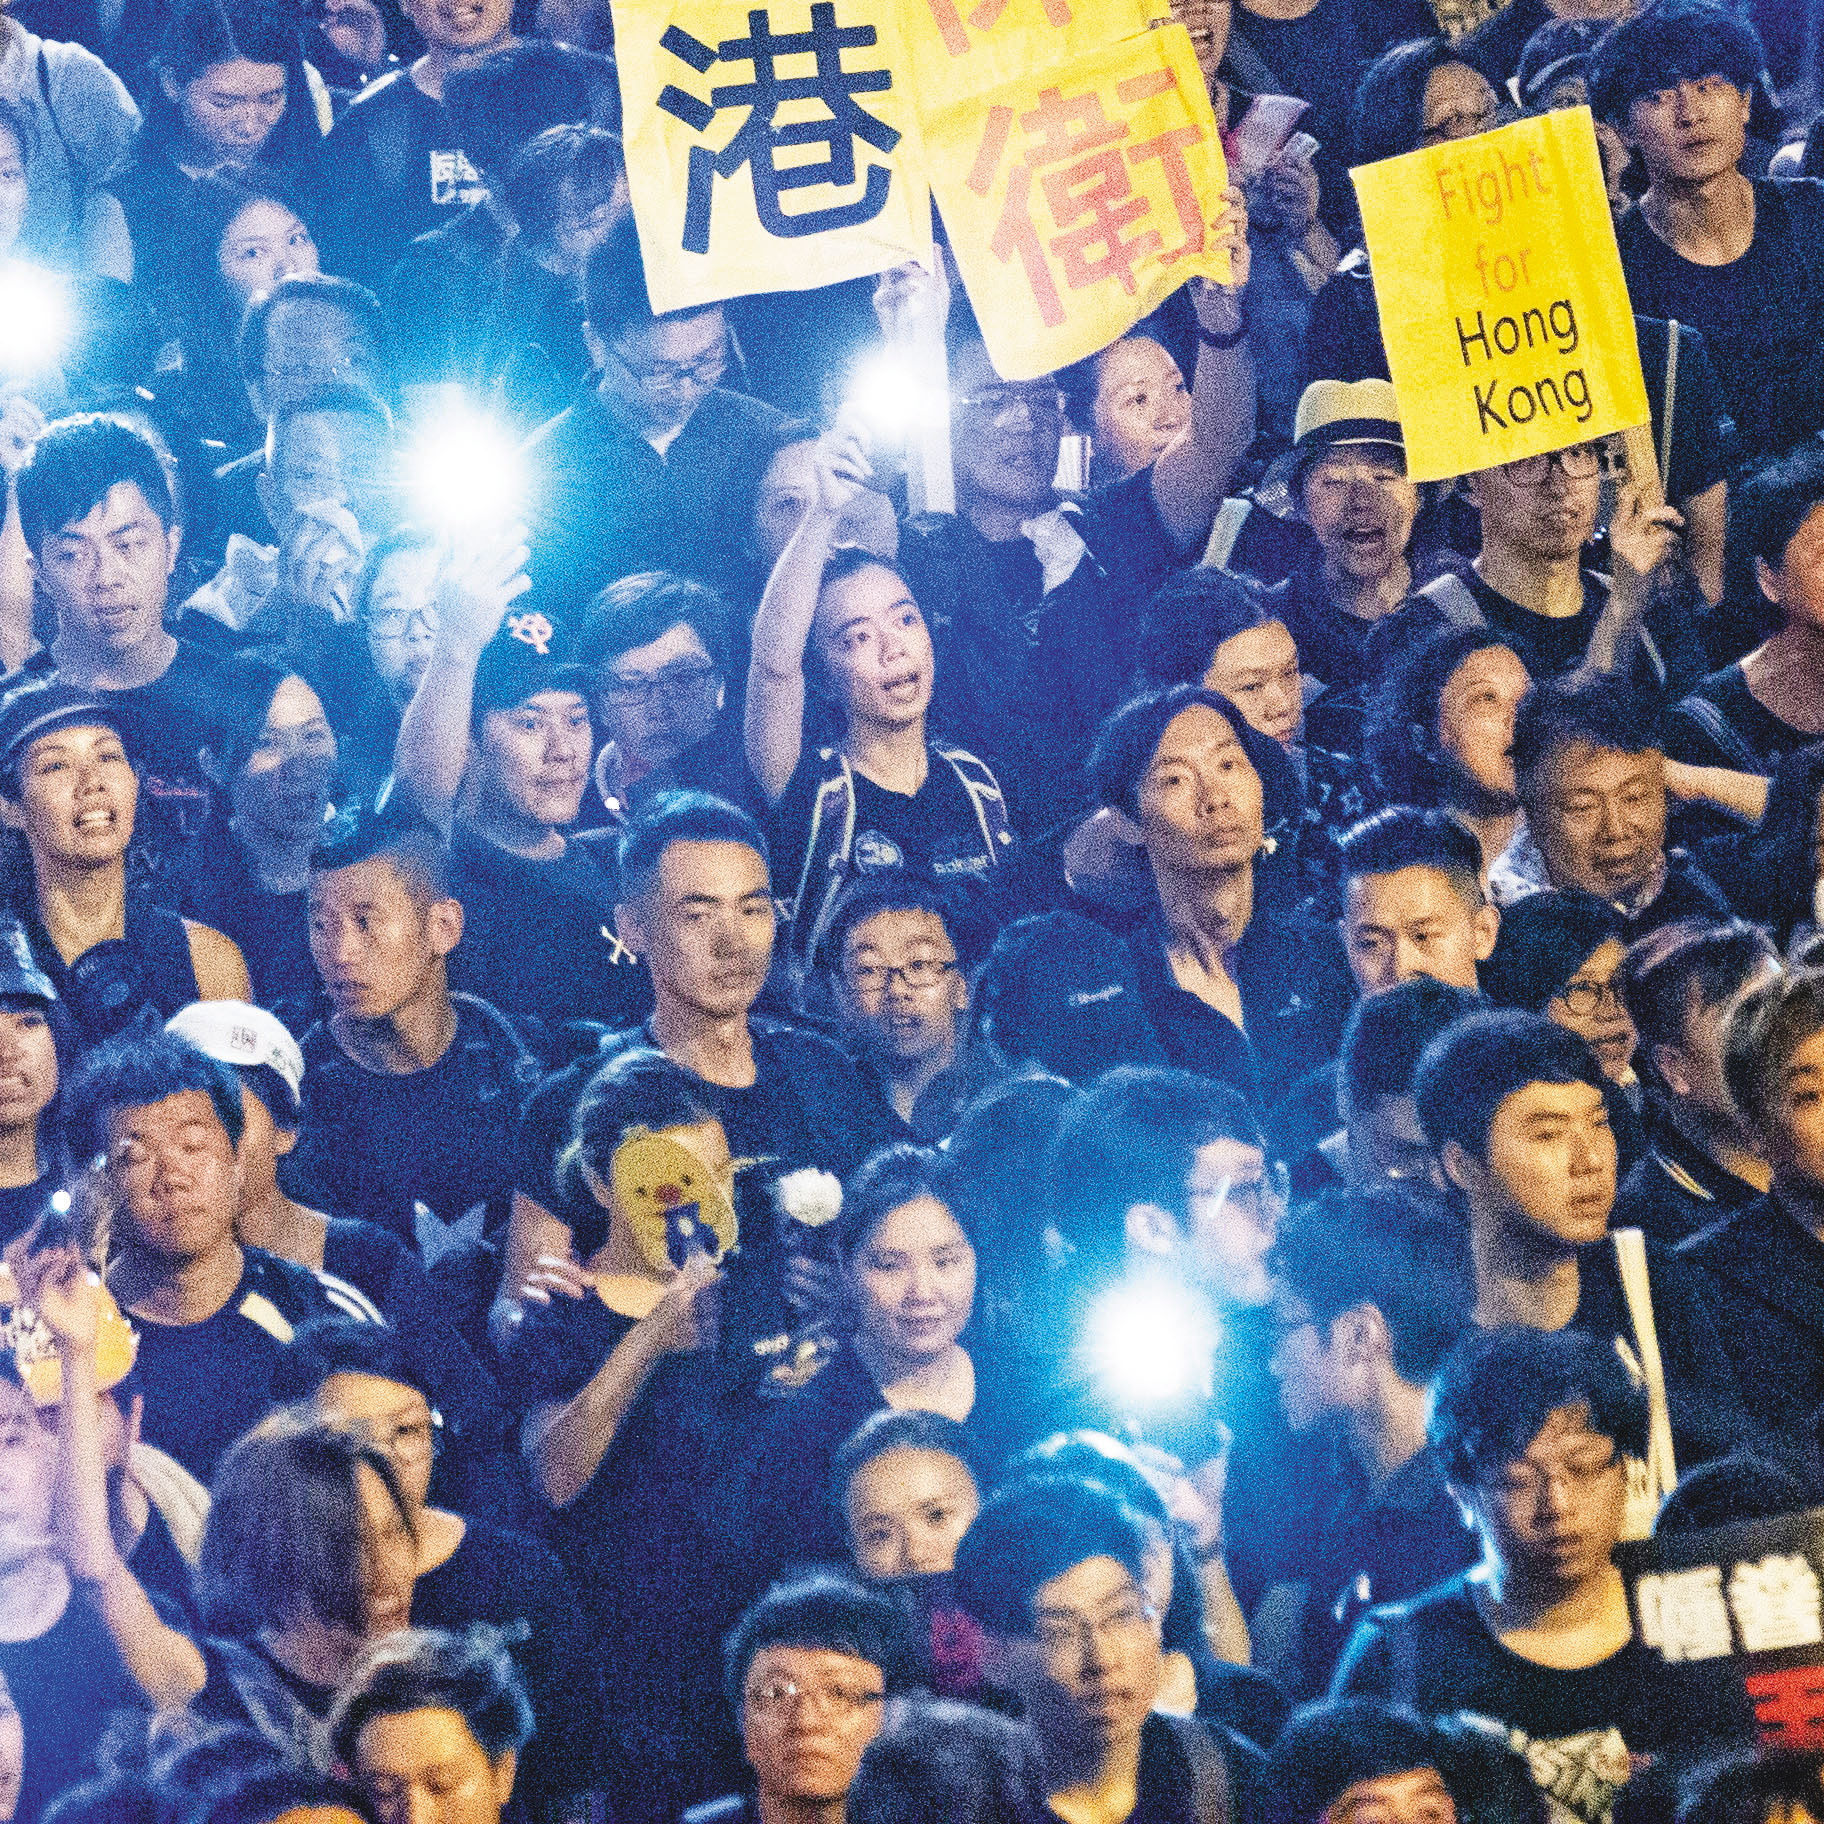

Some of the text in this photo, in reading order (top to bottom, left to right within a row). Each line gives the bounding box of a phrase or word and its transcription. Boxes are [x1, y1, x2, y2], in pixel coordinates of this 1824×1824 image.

[1434, 148, 1551, 228] Fight
[1474, 240, 1534, 297] for
[1455, 298, 1581, 367] Hong
[1475, 366, 1594, 436] Kong
